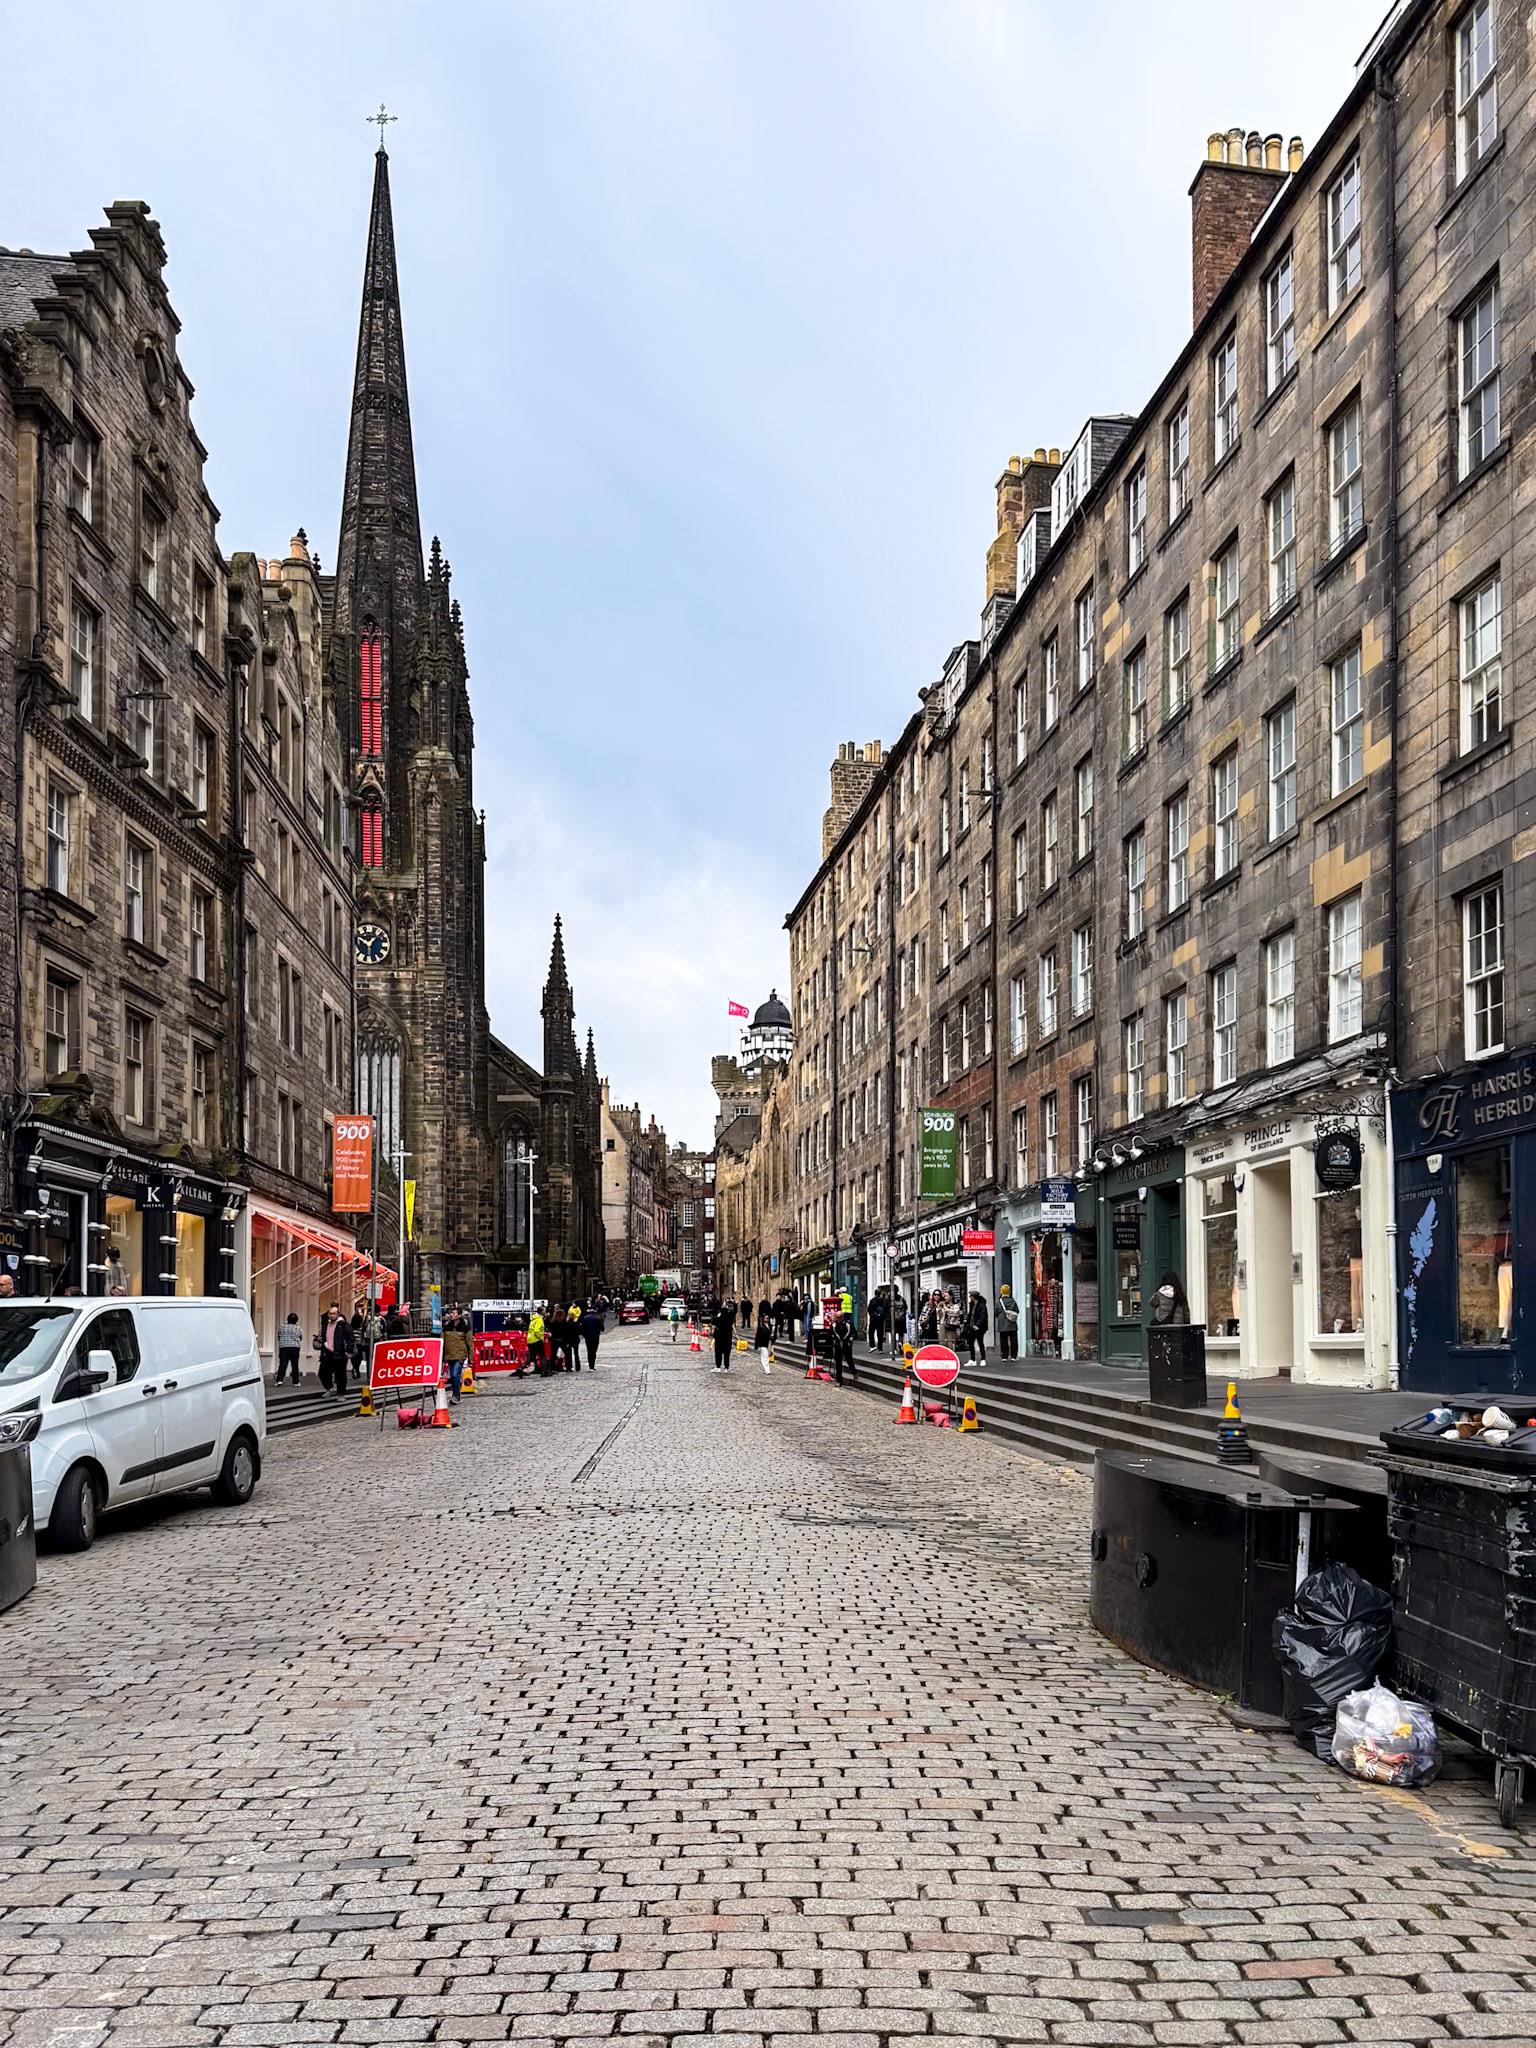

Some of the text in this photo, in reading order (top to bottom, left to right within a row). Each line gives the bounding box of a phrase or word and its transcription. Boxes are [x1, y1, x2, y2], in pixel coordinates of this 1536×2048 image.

[1472, 1067, 1532, 1099] HARRIS
[1474, 1094, 1536, 1125] HEBRID
[336, 1125, 370, 1141] 900
[923, 1117, 955, 1133] 900
[1244, 1119, 1292, 1146] PRINGLE
[1209, 1139, 1234, 1153] SCOTLAND
[1250, 1137, 1284, 1152] OF SCOTLAND
[336, 1149, 367, 1157] Celebrating
[1201, 1153, 1214, 1165] SINCE
[1116, 1156, 1172, 1184] MARCHBRAE
[147, 1186, 161, 1203] K
[180, 1184, 214, 1203] KILTANE
[1417, 1187, 1444, 1198] HEBRIDES
[46, 1207, 69, 1218] DINBURGH
[900, 1236, 918, 1258] HOUS
[918, 1233, 928, 1253] OF
[927, 1222, 964, 1250] SCOTLAND
[387, 1347, 426, 1361] ROAD
[377, 1364, 434, 1380] CLOSED
